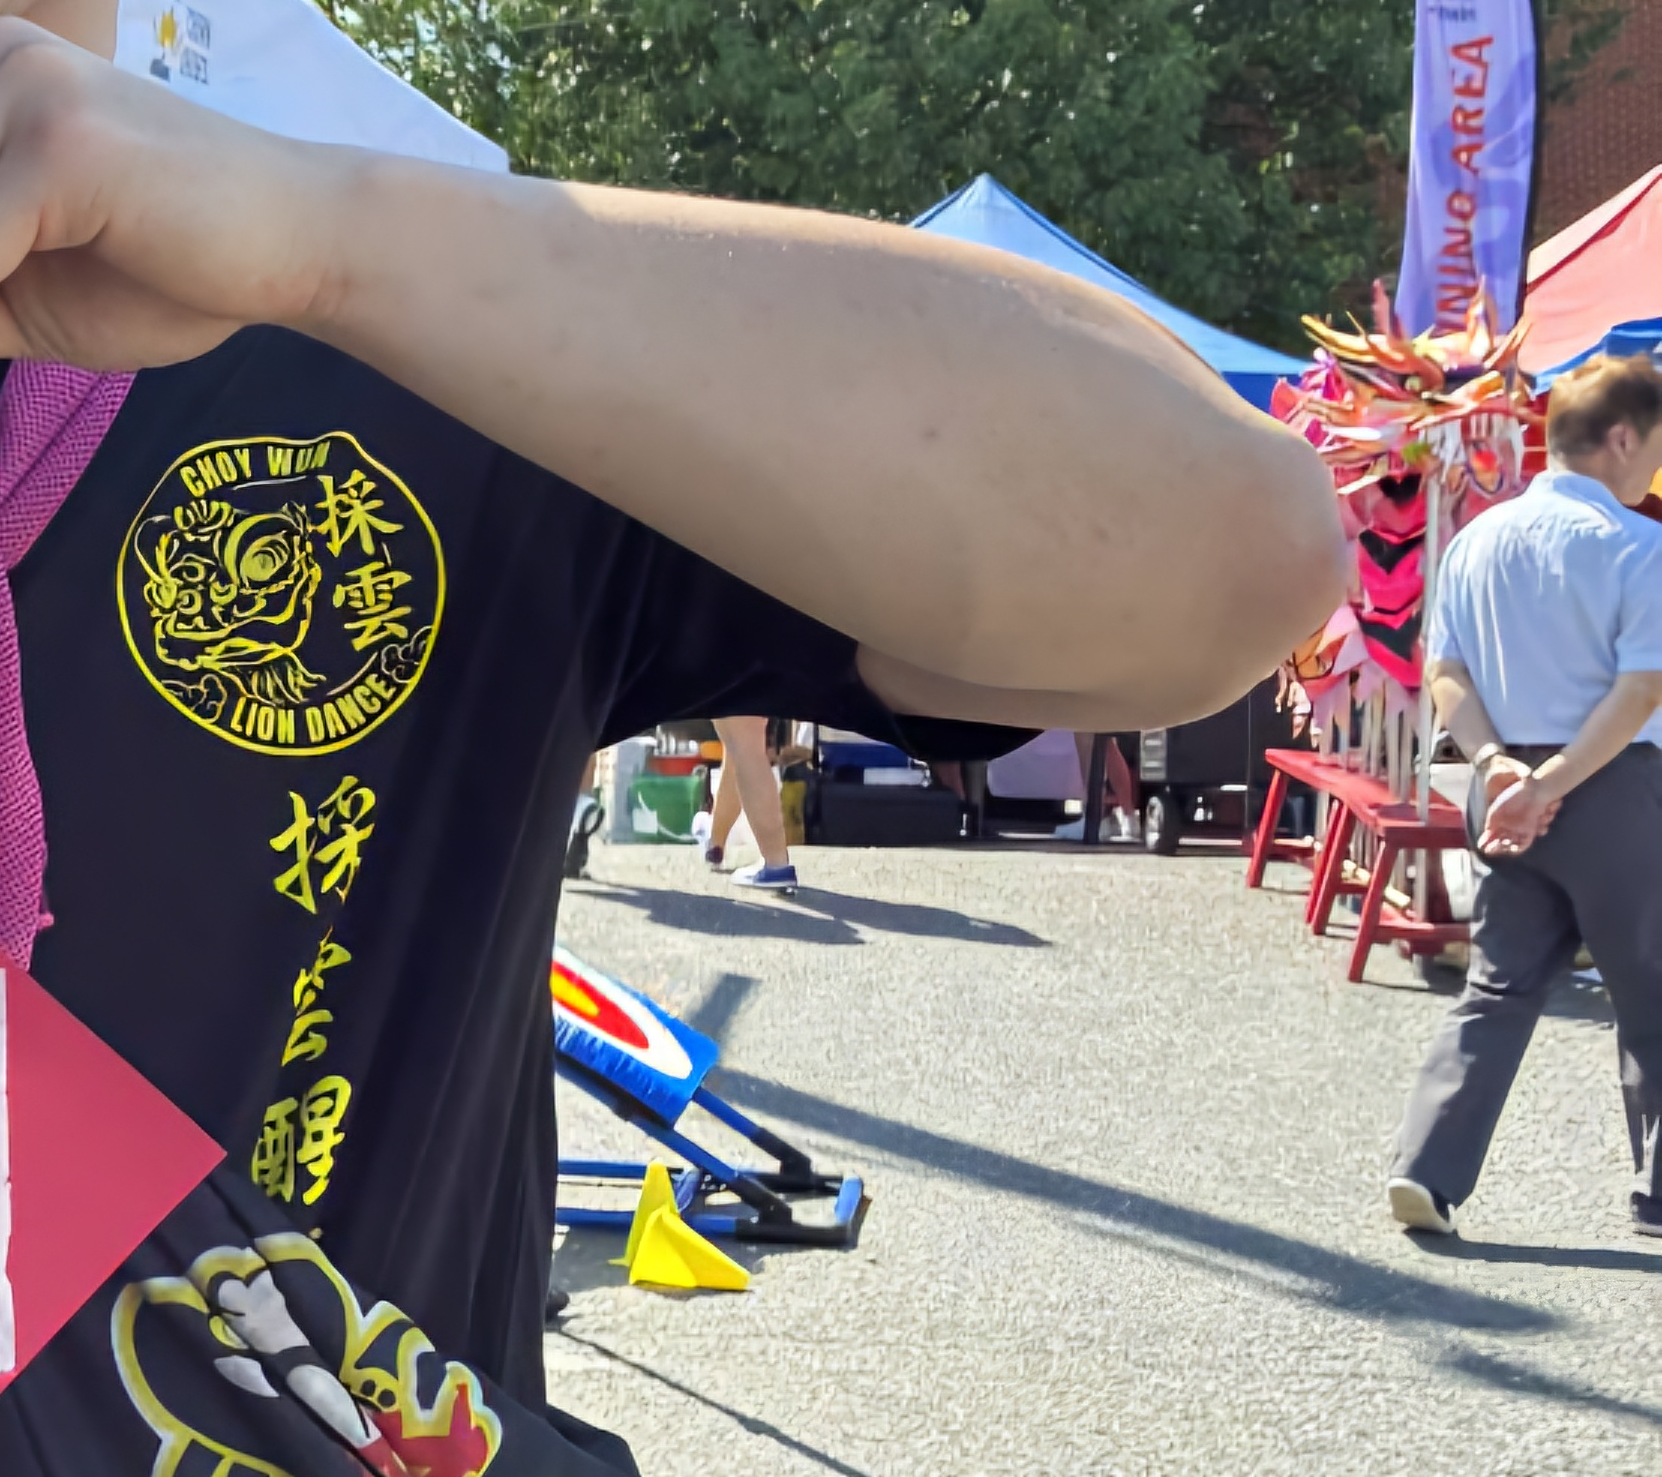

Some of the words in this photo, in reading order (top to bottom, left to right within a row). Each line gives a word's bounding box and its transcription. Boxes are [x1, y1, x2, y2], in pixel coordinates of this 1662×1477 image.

[1450, 36, 1494, 178] AREA
[180, 447, 253, 498] CHOY
[231, 695, 297, 745] LION
[305, 672, 396, 743] DANCE
